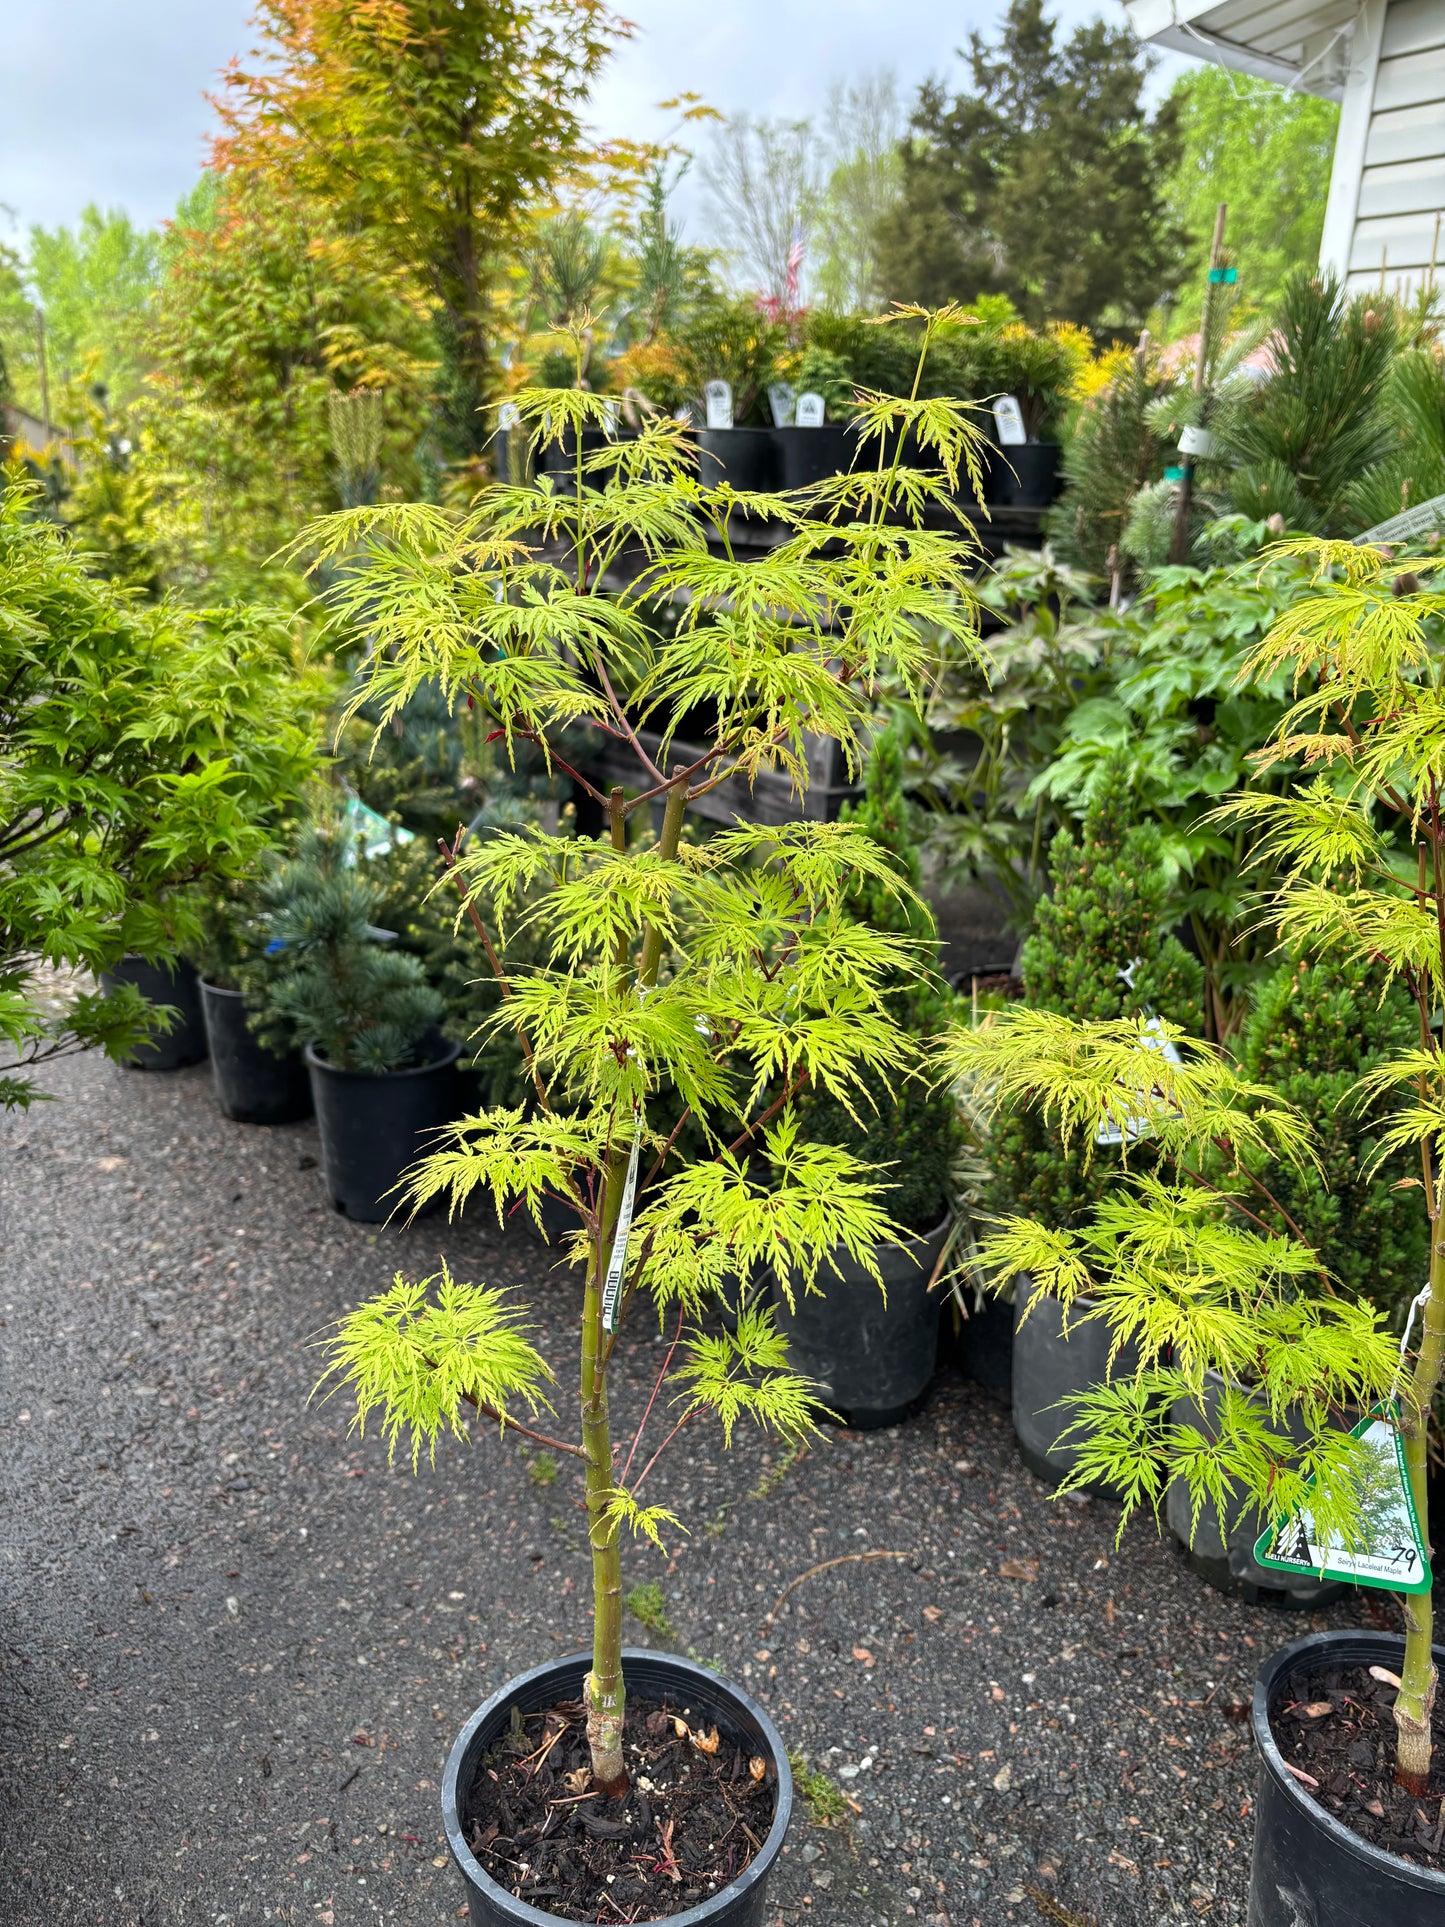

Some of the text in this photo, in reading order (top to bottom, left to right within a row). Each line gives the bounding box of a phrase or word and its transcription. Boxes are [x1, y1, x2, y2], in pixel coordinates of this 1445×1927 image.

[1357, 1560, 1383, 1571] Laceleaf
[1383, 1564, 1402, 1575] Maple
[1391, 1547, 1416, 1573] 79
